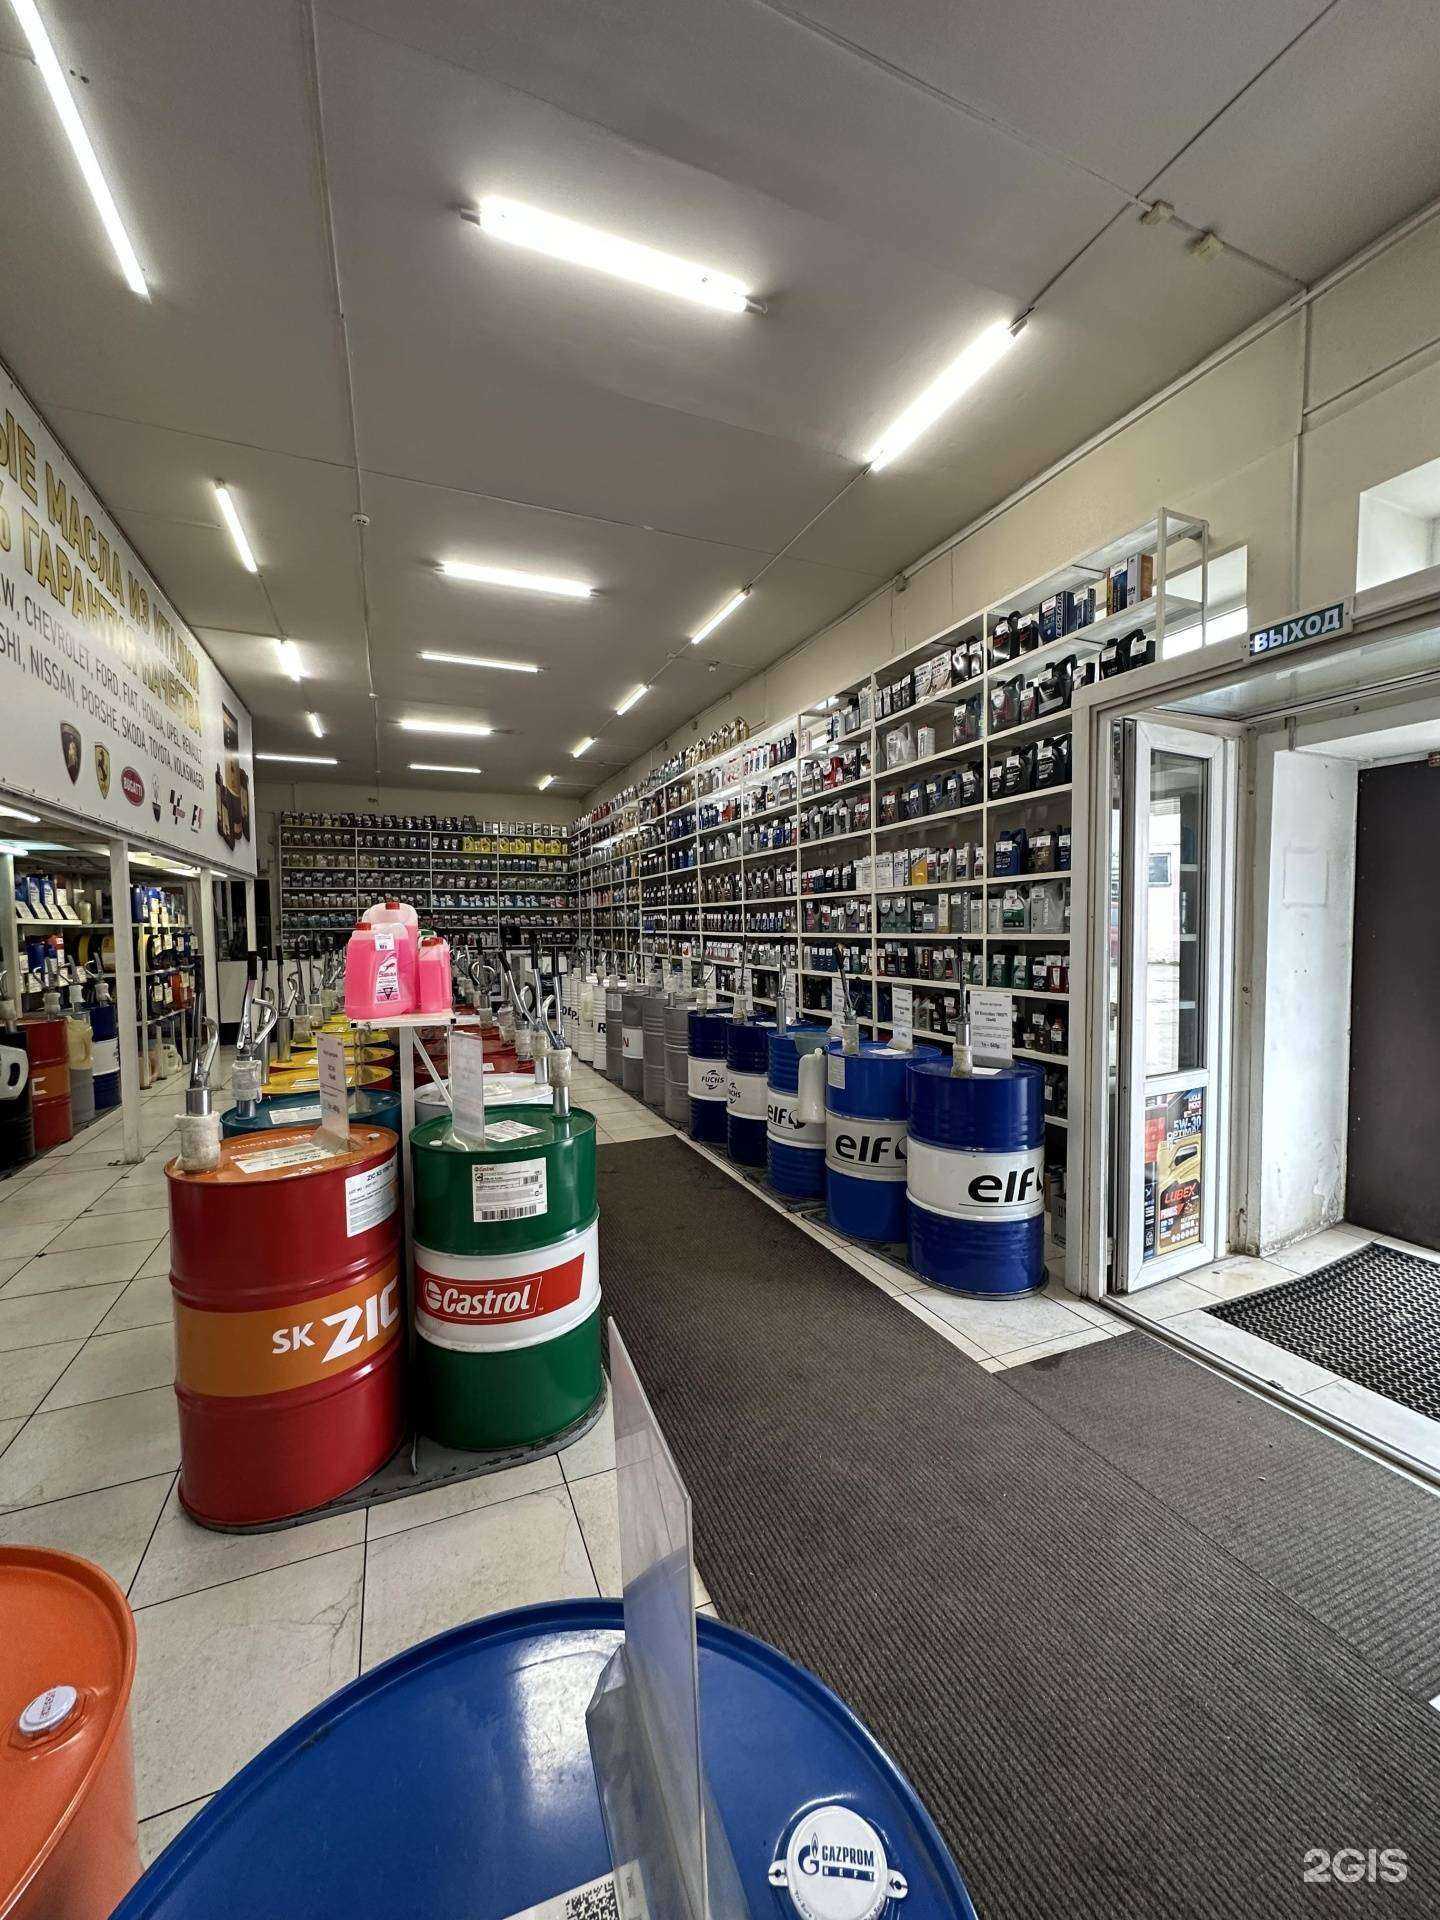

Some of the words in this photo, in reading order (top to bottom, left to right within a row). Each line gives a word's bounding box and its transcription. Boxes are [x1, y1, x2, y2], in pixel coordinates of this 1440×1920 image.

[45, 461, 125, 608] МАСЛА
[128, 570, 150, 637] ИЗ
[24, 595, 94, 679] CHEVROLET,
[1253, 608, 1341, 653] ВЫХОД
[30, 645, 80, 709] NISSAN,
[81, 684, 120, 735] PORSHE,
[174, 755, 205, 792] VOLKSWAGEN
[701, 1076, 725, 1084] FUCHS
[768, 1104, 787, 1124] elf
[835, 1134, 892, 1164] elf
[968, 1167, 1035, 1203] elf
[1165, 1182, 1198, 1204] LUBEX
[442, 1284, 531, 1315] Castrol
[272, 1322, 316, 1354] SK
[321, 1275, 399, 1364] ZIC
[821, 1845, 875, 1868] GAZPROM
